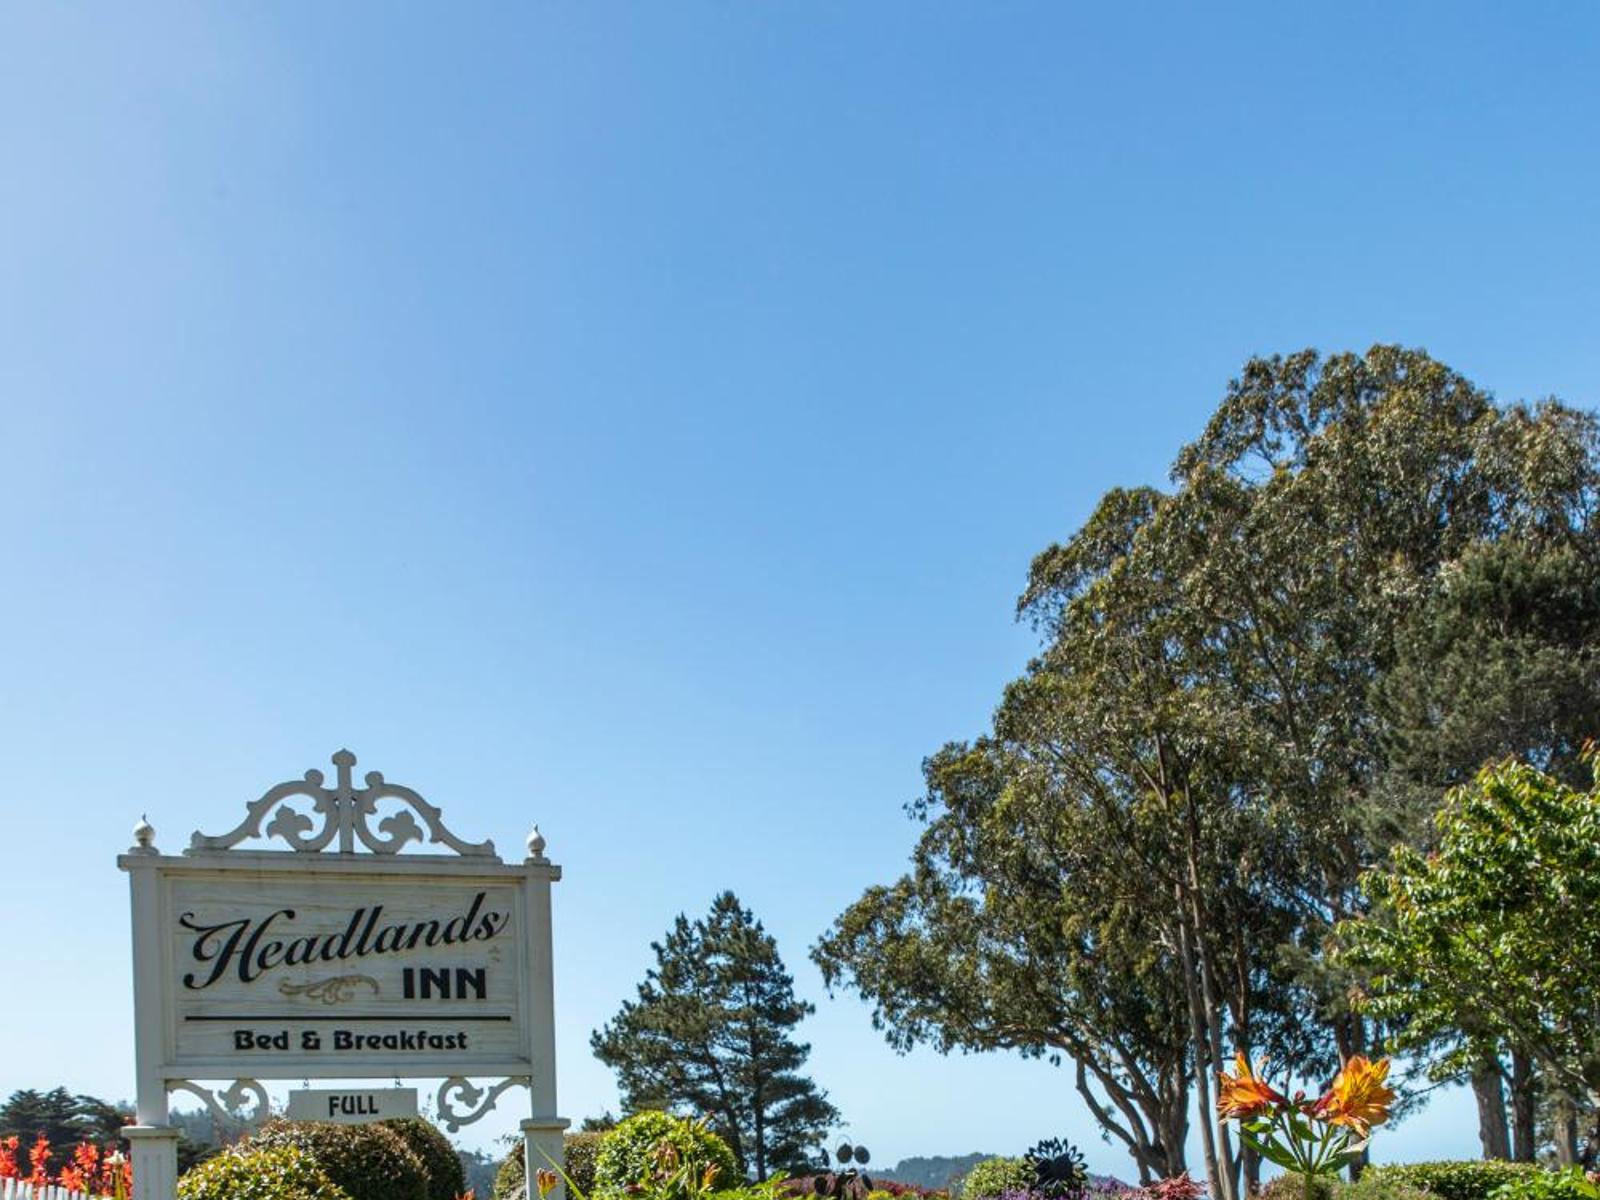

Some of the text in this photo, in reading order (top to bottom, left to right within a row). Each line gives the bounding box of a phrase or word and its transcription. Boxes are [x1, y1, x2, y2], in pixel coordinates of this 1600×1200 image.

[179, 892, 510, 990] Headlands
[402, 967, 487, 1000] INN
[234, 1029, 468, 1050] Bed & Breakfast
[328, 1095, 379, 1117] FULL
